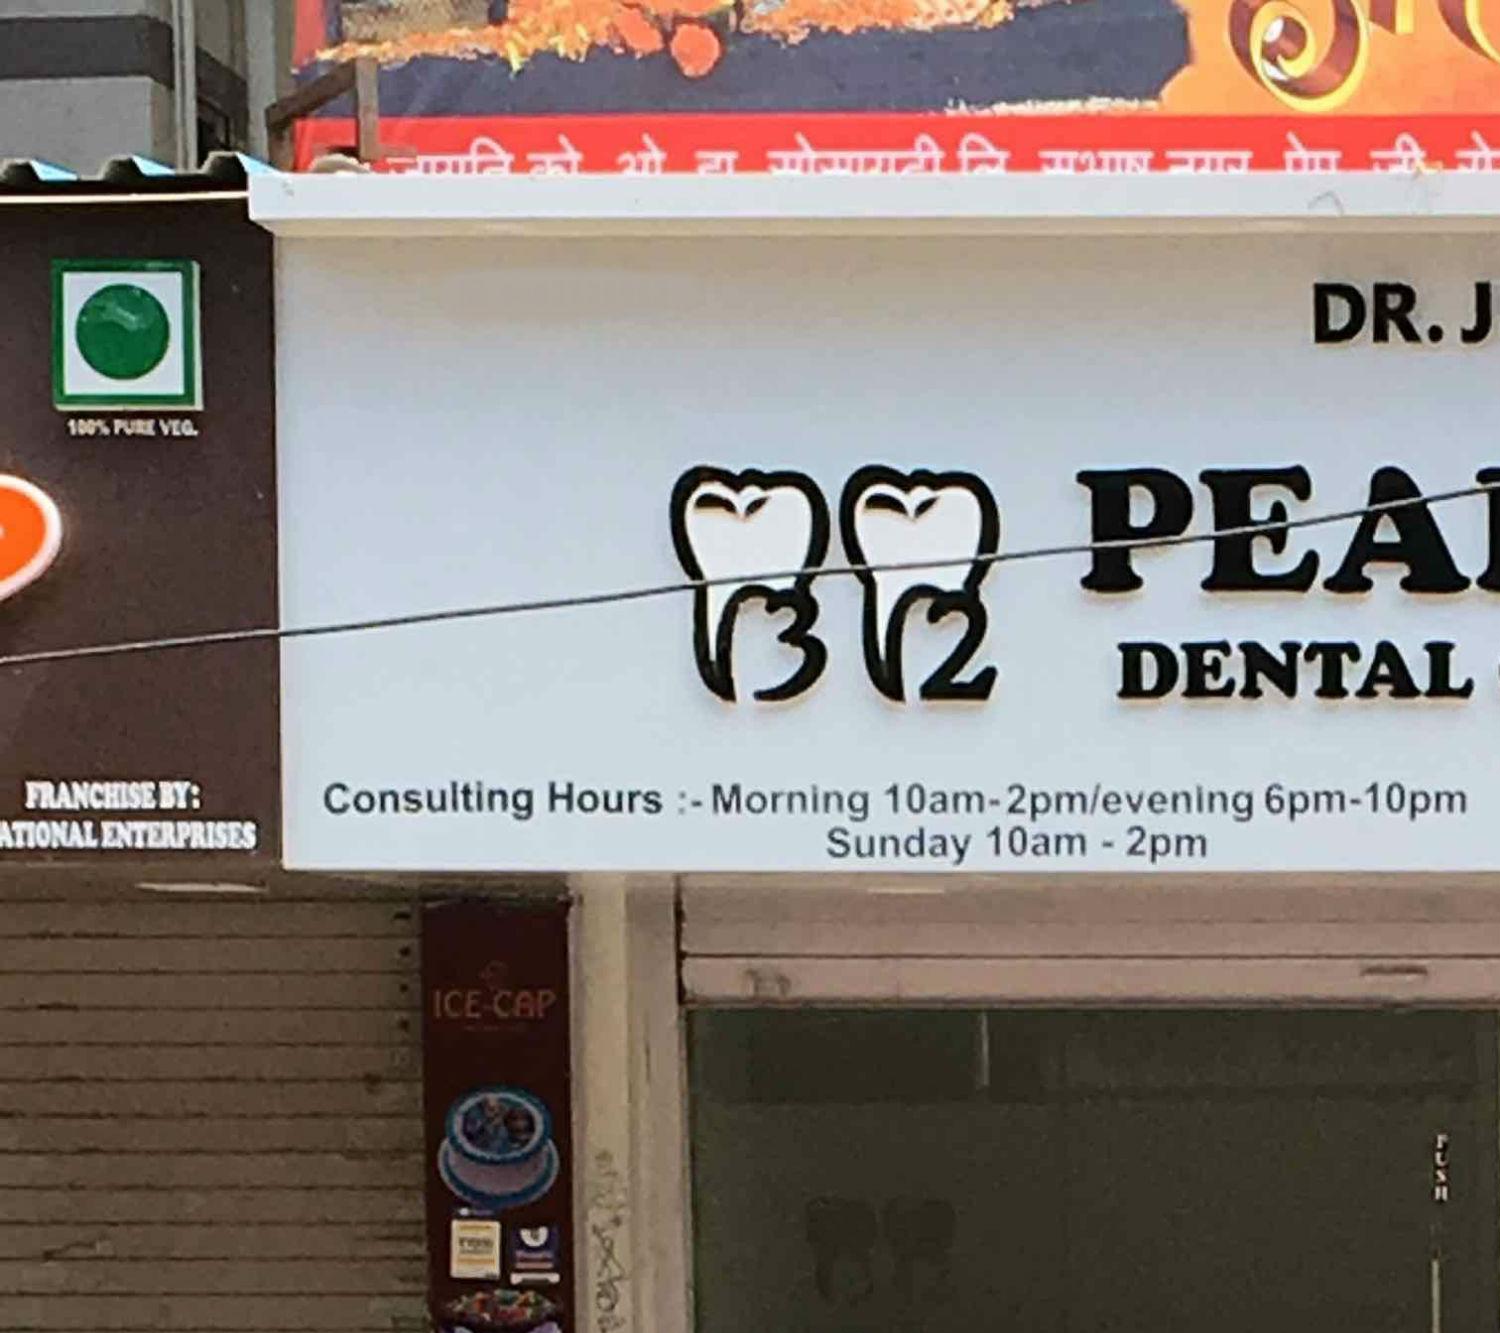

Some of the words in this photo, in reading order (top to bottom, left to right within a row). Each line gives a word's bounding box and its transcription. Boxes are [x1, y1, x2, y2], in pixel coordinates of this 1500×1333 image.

[1313, 281, 1444, 344] DR.
[113, 418, 156, 436] PURE
[1117, 640, 1473, 699] DENTAL
[24, 780, 155, 809] FRANCHISE
[158, 780, 200, 809] BY:
[323, 782, 534, 821] Consulting
[549, 782, 662, 815] Hours
[712, 784, 869, 823] Morning
[1266, 782, 1467, 822] 6pm-10pm
[101, 820, 257, 849] ENTERPRISES
[827, 827, 971, 866] Sunday
[987, 826, 1086, 857] 10am
[1126, 826, 1207, 864] 2pm
